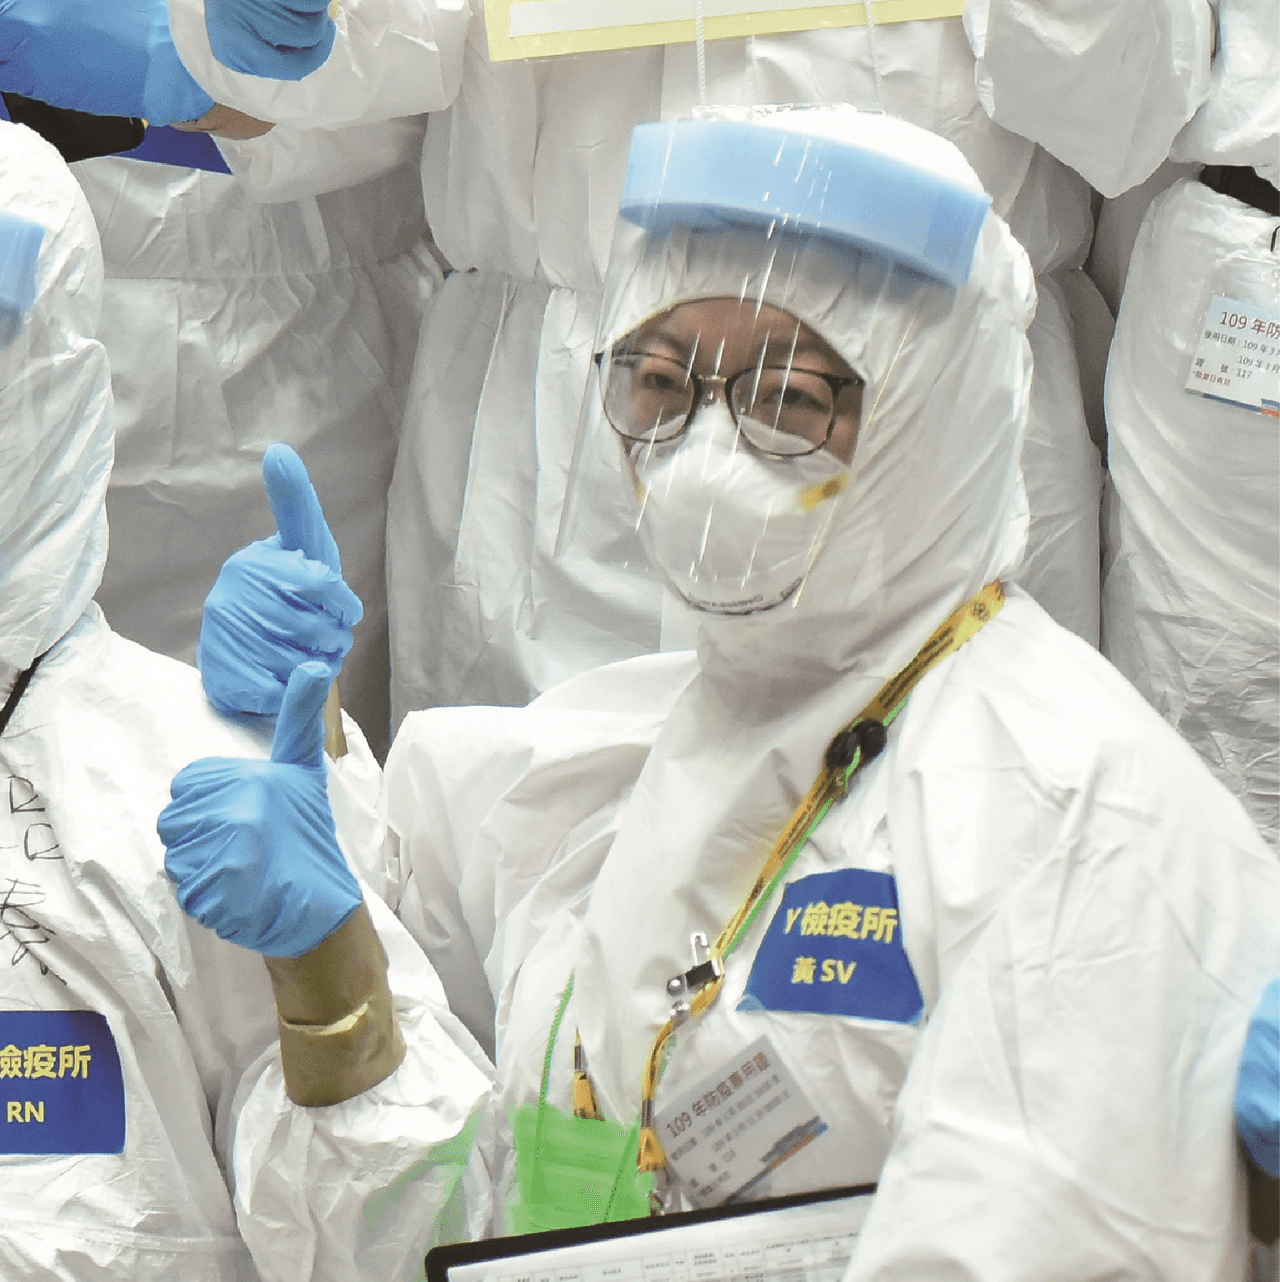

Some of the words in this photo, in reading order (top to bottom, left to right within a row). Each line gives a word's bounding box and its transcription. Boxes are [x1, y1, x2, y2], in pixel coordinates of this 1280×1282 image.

[1219, 311, 1248, 330] 109
[783, 906, 803, 935] Y
[800, 899, 899, 945] 檢疫所
[6, 1101, 45, 1124] RN
